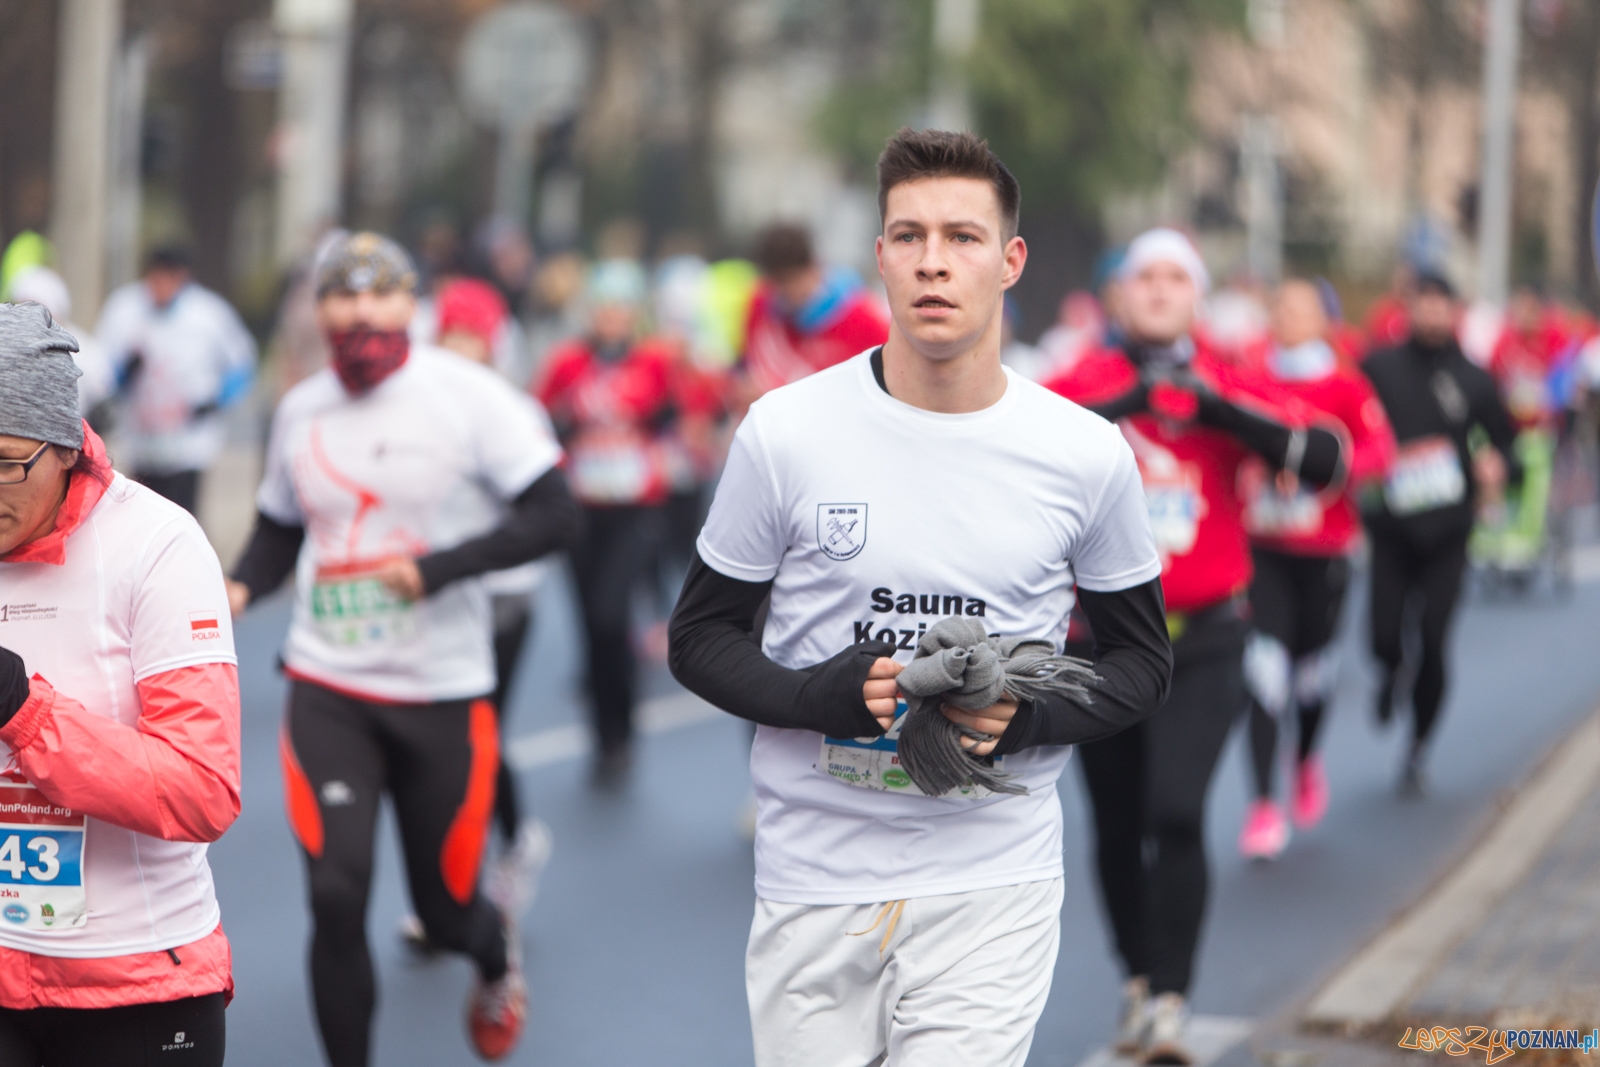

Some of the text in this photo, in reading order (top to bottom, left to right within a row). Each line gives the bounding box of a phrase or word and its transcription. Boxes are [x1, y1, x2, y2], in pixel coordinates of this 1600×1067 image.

[870, 587, 987, 618] Sauna
[191, 631, 220, 641] POLSKA
[828, 763, 856, 774] GRUPA
[162, 1042, 194, 1050] DOMYOS
